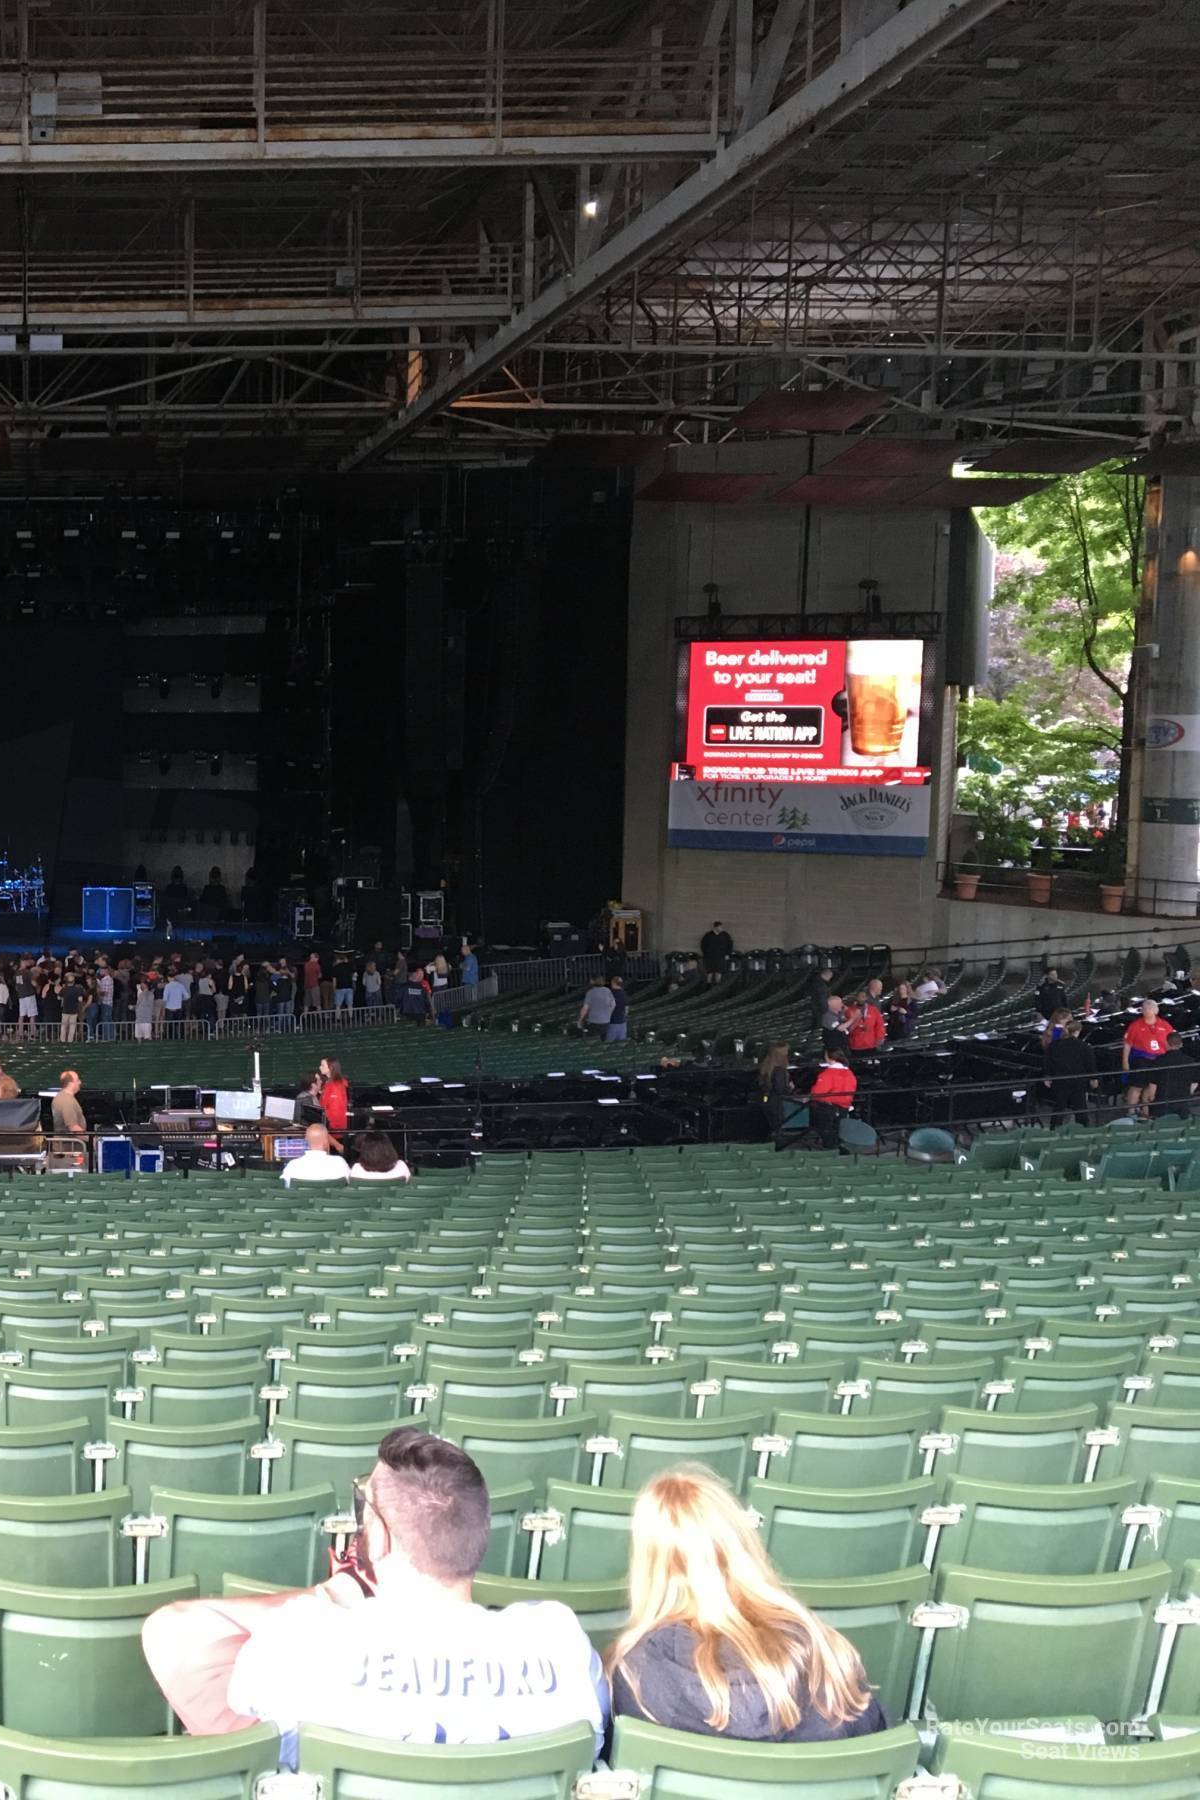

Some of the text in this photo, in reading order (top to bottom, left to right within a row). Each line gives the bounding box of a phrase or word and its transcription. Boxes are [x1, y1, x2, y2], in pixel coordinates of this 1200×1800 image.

[705, 649, 828, 666] Beer delivered
[713, 669, 816, 688] to your seat!
[740, 711, 787, 722] Get the
[729, 726, 817, 741] LIVE NATION APP
[703, 766, 766, 774] DOWNLOAD
[767, 767, 789, 775] THE
[817, 768, 858, 776] NATION
[860, 769, 884, 777] APP
[696, 781, 784, 809] xfinity
[840, 787, 912, 813] JACK DANIEL'S
[703, 809, 773, 826] center
[787, 838, 817, 847] pepsi
